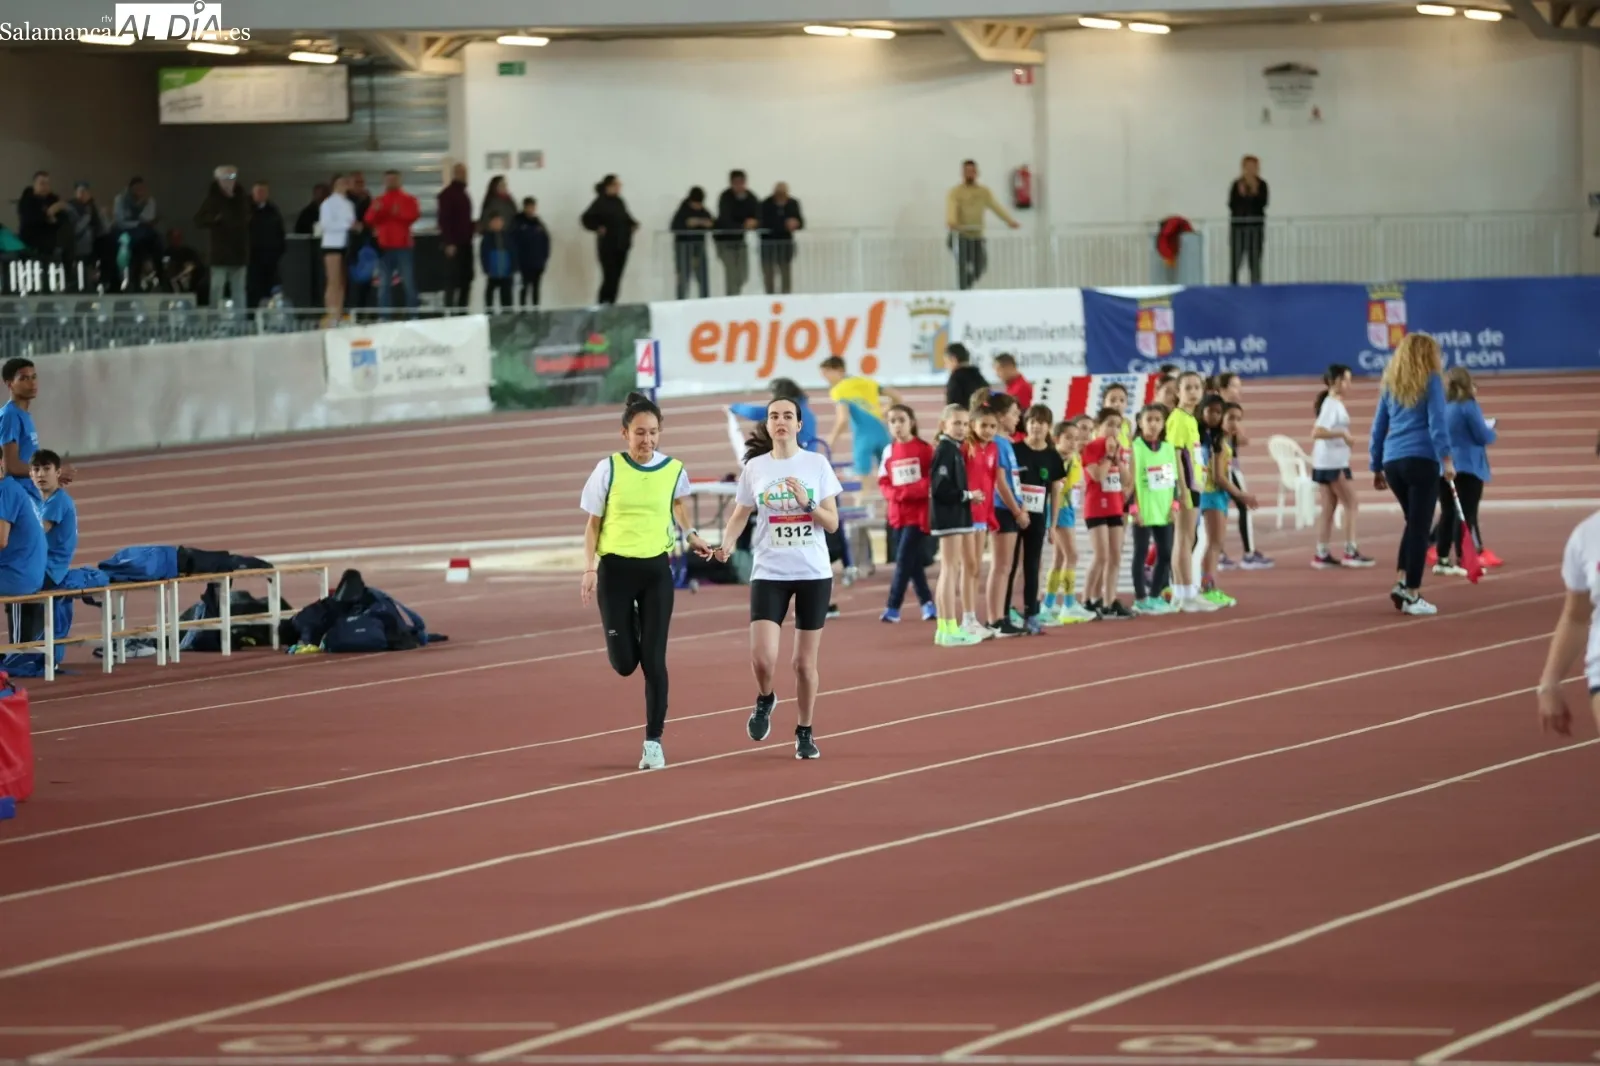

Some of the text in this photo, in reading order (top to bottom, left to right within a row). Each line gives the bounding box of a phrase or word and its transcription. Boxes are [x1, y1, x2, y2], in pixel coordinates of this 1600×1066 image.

[690, 300, 886, 378] enjoy!
[1180, 334, 1268, 356] Junta de
[1477, 328, 1504, 346] de
[636, 341, 656, 377] 4
[1219, 354, 1269, 375] León
[1455, 347, 1506, 368] León
[775, 524, 813, 538] 1312
